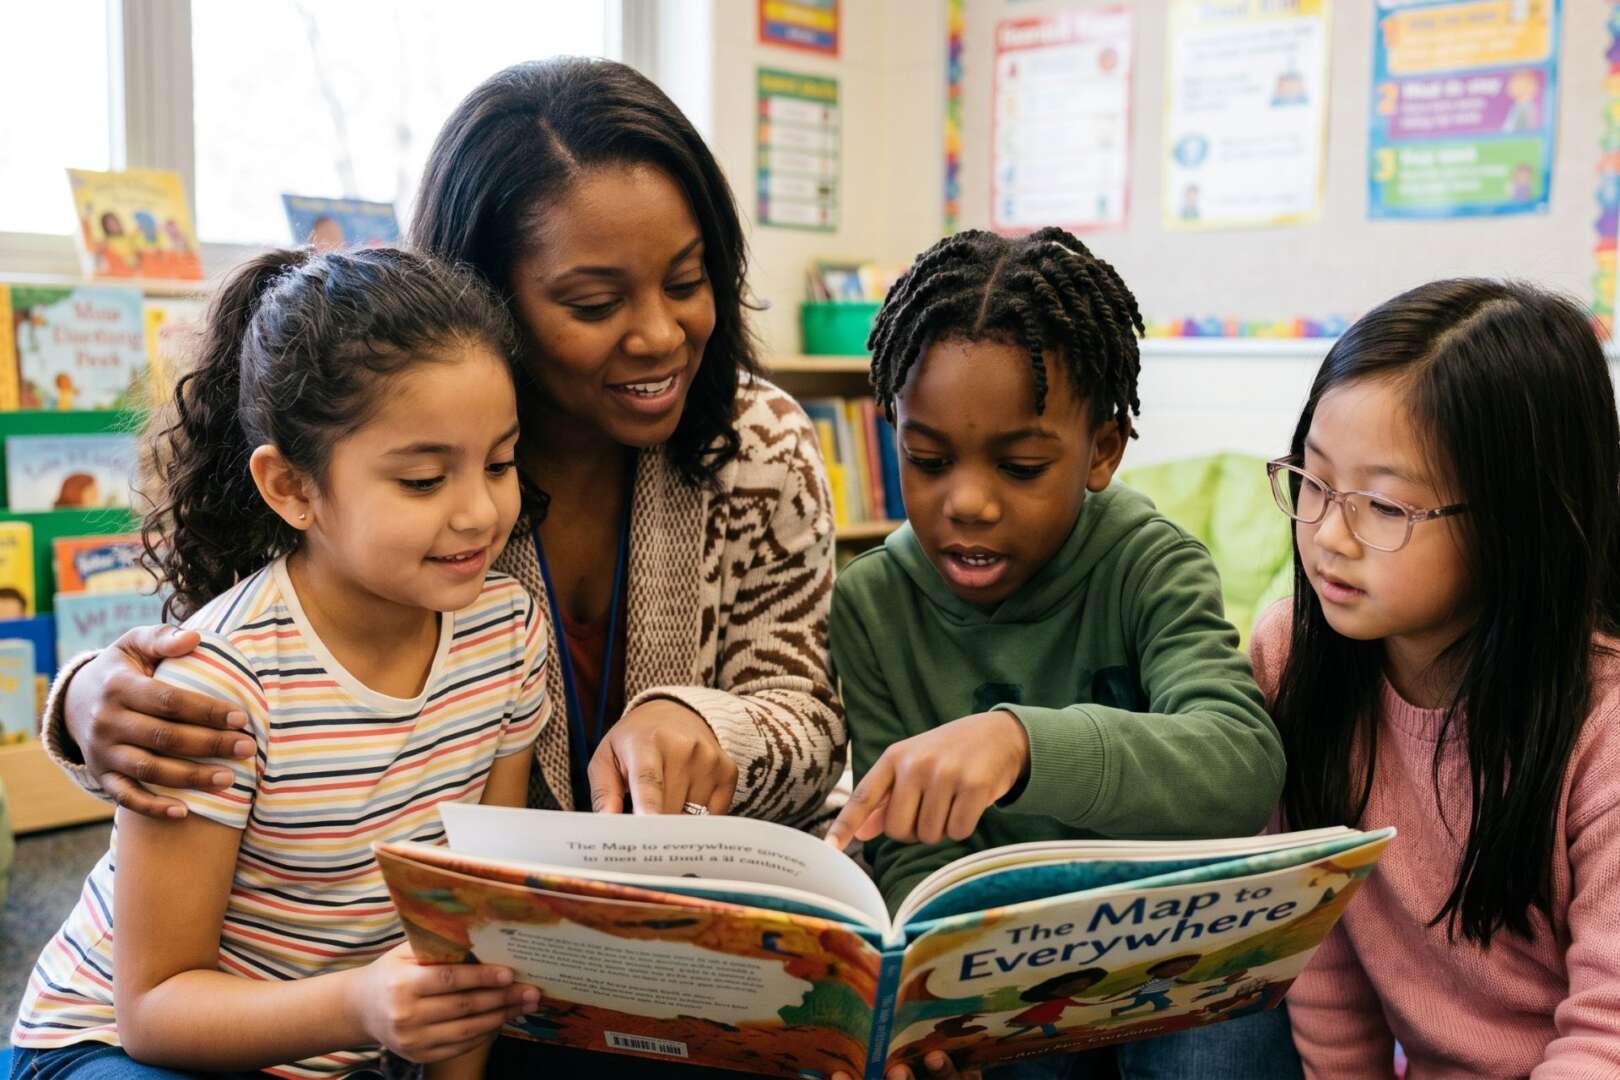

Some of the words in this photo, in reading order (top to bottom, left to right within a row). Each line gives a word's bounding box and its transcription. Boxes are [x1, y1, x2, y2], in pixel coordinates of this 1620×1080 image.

[566, 840, 597, 851] The
[602, 841, 638, 853] Map
[642, 842, 658, 851] to
[662, 841, 753, 854] everywhere
[959, 900, 1298, 981] Everywhere
[1006, 922, 1075, 944] The
[1086, 891, 1221, 933] Map
[1235, 886, 1272, 902] to
